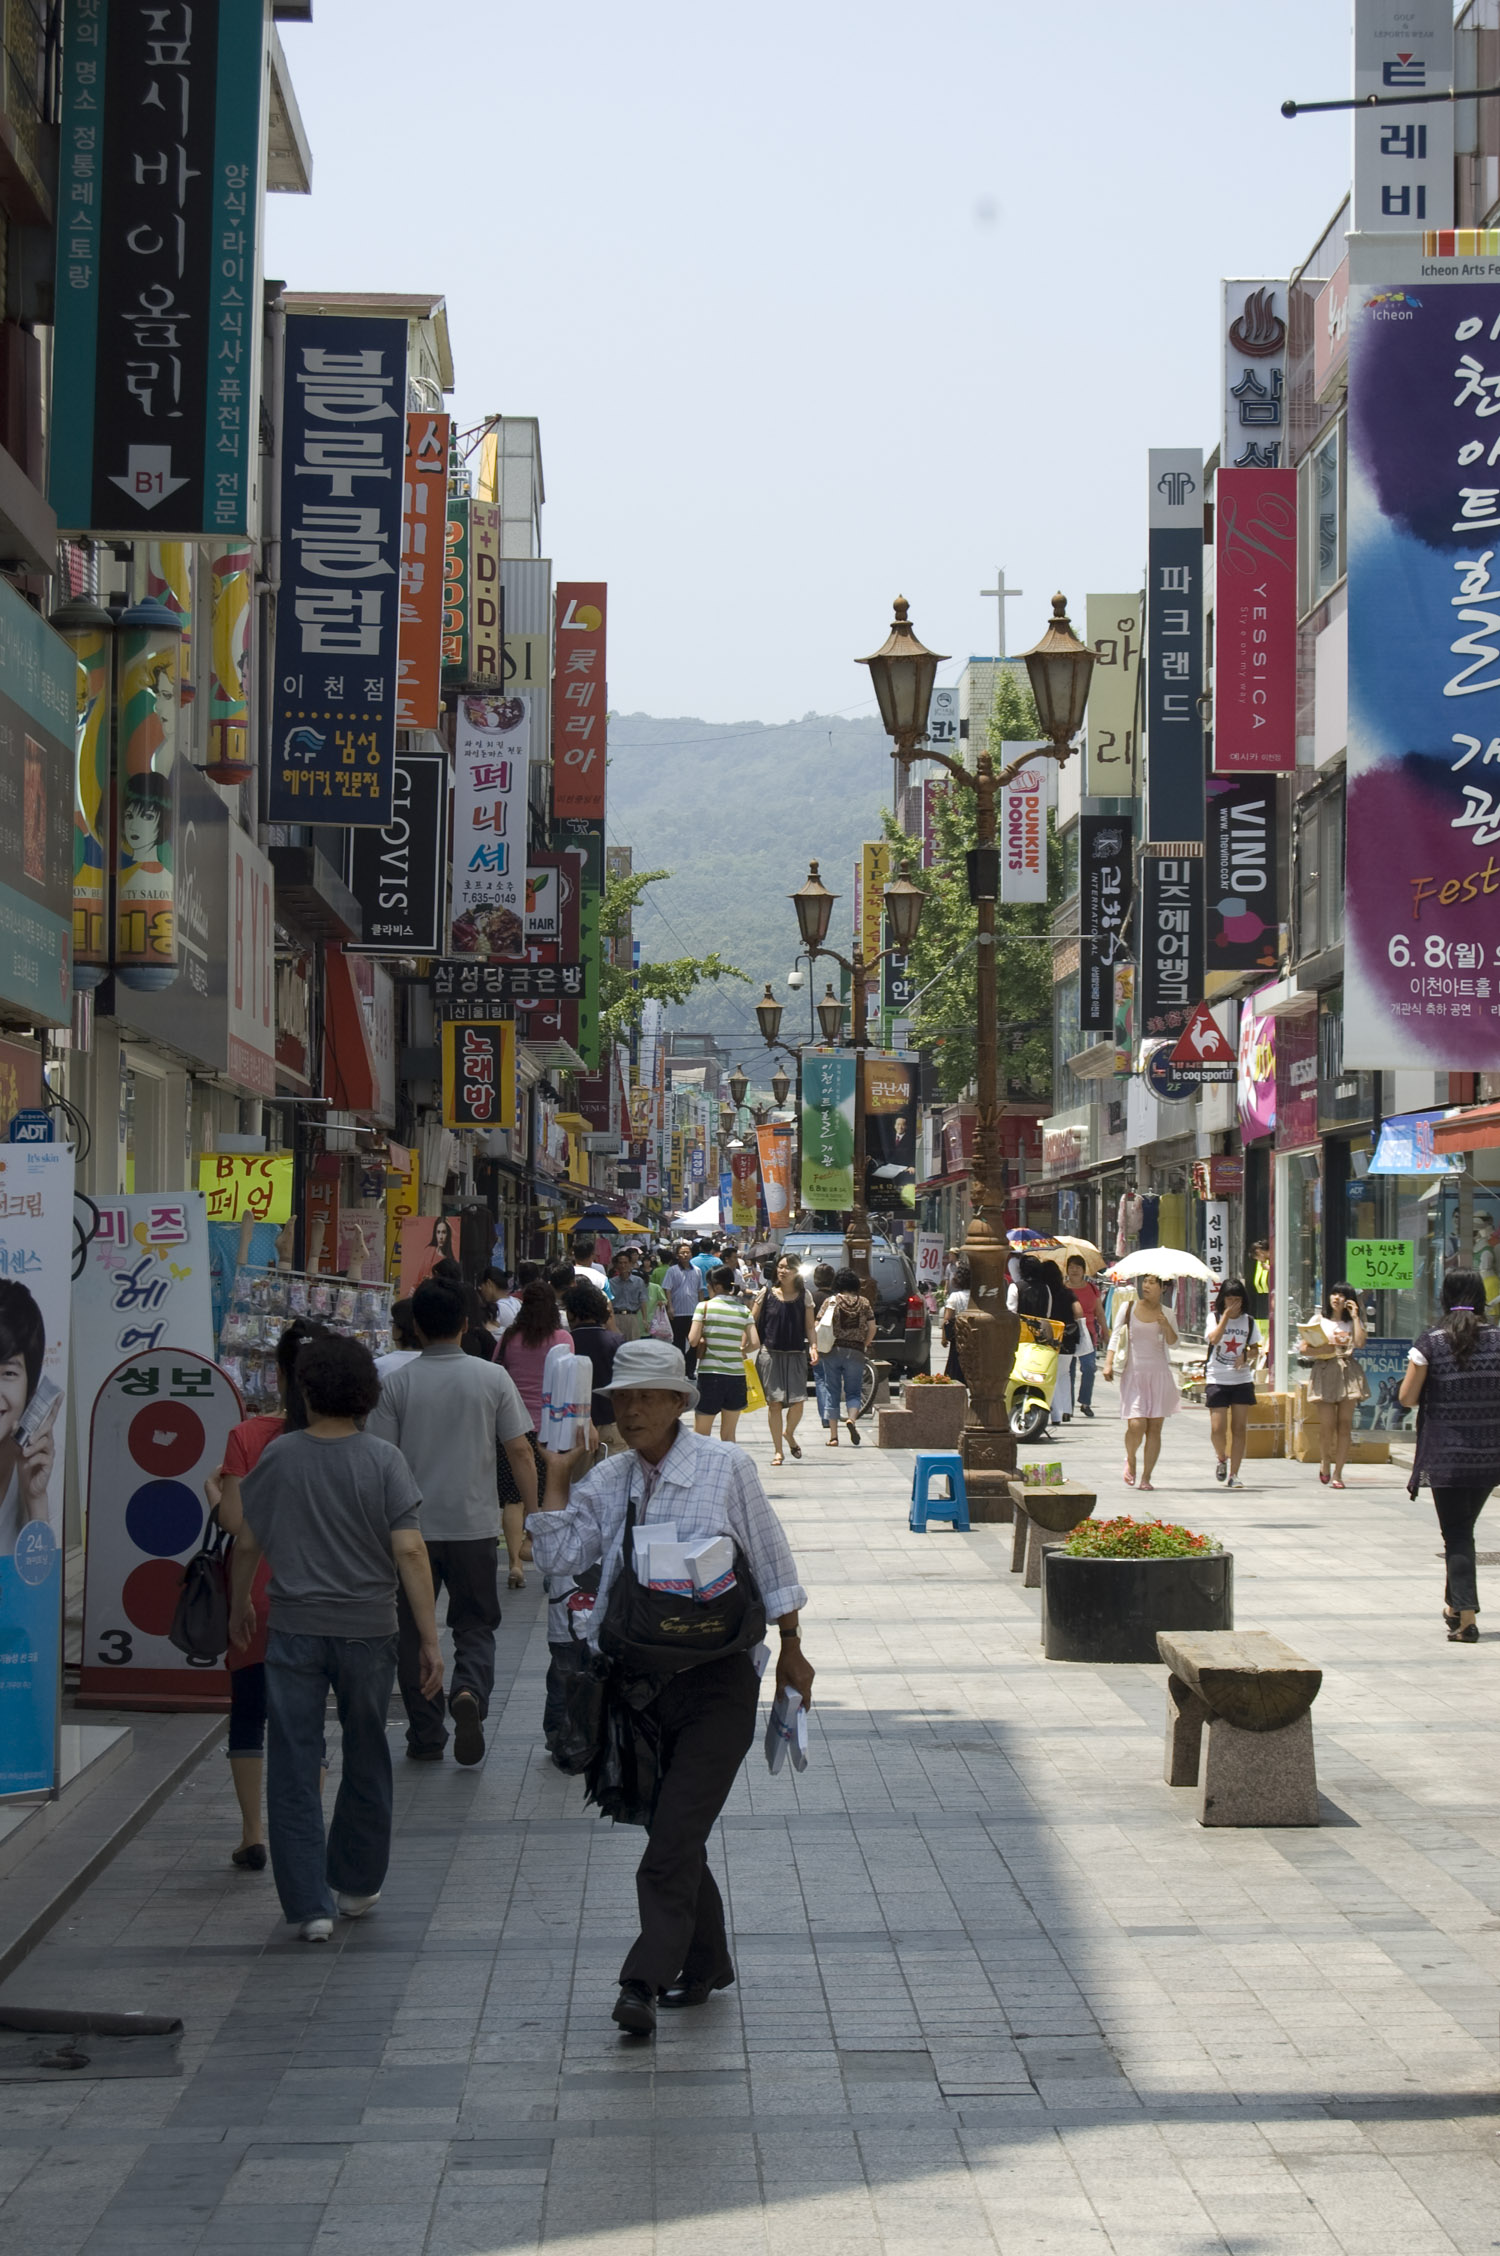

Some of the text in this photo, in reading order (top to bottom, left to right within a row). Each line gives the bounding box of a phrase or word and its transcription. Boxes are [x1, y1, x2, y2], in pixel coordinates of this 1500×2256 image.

[73, 61, 97, 111] 명소
[1380, 61, 1428, 219] 트레비
[222, 163, 249, 216] 양식
[68, 126, 97, 290] 정통레스토랑
[1421, 264, 1459, 277] Icheon
[1461, 264, 1486, 276] Arts
[1372, 309, 1413, 321] Icheon
[134, 472, 165, 495] B1
[212, 471, 240, 525] 전문
[291, 348, 399, 655] 블루클럽
[473, 506, 499, 530] 노래
[1159, 565, 1192, 721] 파크랜드
[1238, 606, 1249, 704] Stye on my way
[1251, 582, 1267, 730] YESSICA
[563, 648, 597, 774] 롯데리아
[931, 720, 957, 744] 칸
[335, 730, 381, 765] 남성
[282, 769, 380, 798] 헤어컷 전문점
[1008, 796, 1023, 870] DONUTS
[1025, 796, 1040, 874] DUNKIN'
[1230, 800, 1267, 892] VINO
[869, 847, 884, 880] VIP
[462, 892, 517, 904] T.635-0149
[529, 918, 555, 930] HAIR
[1090, 872, 1099, 956] INTERNATIONAL
[233, 852, 270, 1028] BYC
[370, 924, 414, 937] 클라비스
[434, 966, 583, 994] 삼성당금은방
[1410, 977, 1492, 998] 이천아트홀
[1390, 1003, 1471, 1016] 개관식 축하 공연
[463, 1029, 496, 1120] 노래방
[1172, 1069, 1181, 1080] le
[1182, 1071, 1201, 1082] coq
[1201, 1068, 1234, 1082] sportif
[820, 1062, 836, 1139] 이천아트홀
[870, 1081, 910, 1098] 금난새
[871, 1095, 881, 1107] &
[580, 1104, 608, 1113] VENUS
[16, 1124, 48, 1140] ADT
[41, 1153, 60, 1163] skin
[216, 1155, 274, 1178] BYC
[207, 1180, 274, 1221] 폐업
[95, 1206, 186, 1245] 미즈
[1208, 1213, 1225, 1273] 신바람
[919, 1247, 939, 1270] 30
[1365, 1259, 1413, 1281] 50% SALE
[1223, 1328, 1248, 1337] APPOR
[1379, 1356, 1410, 1374] SALE
[114, 1366, 215, 1397] 성보
[26, 1533, 43, 1553] 24
